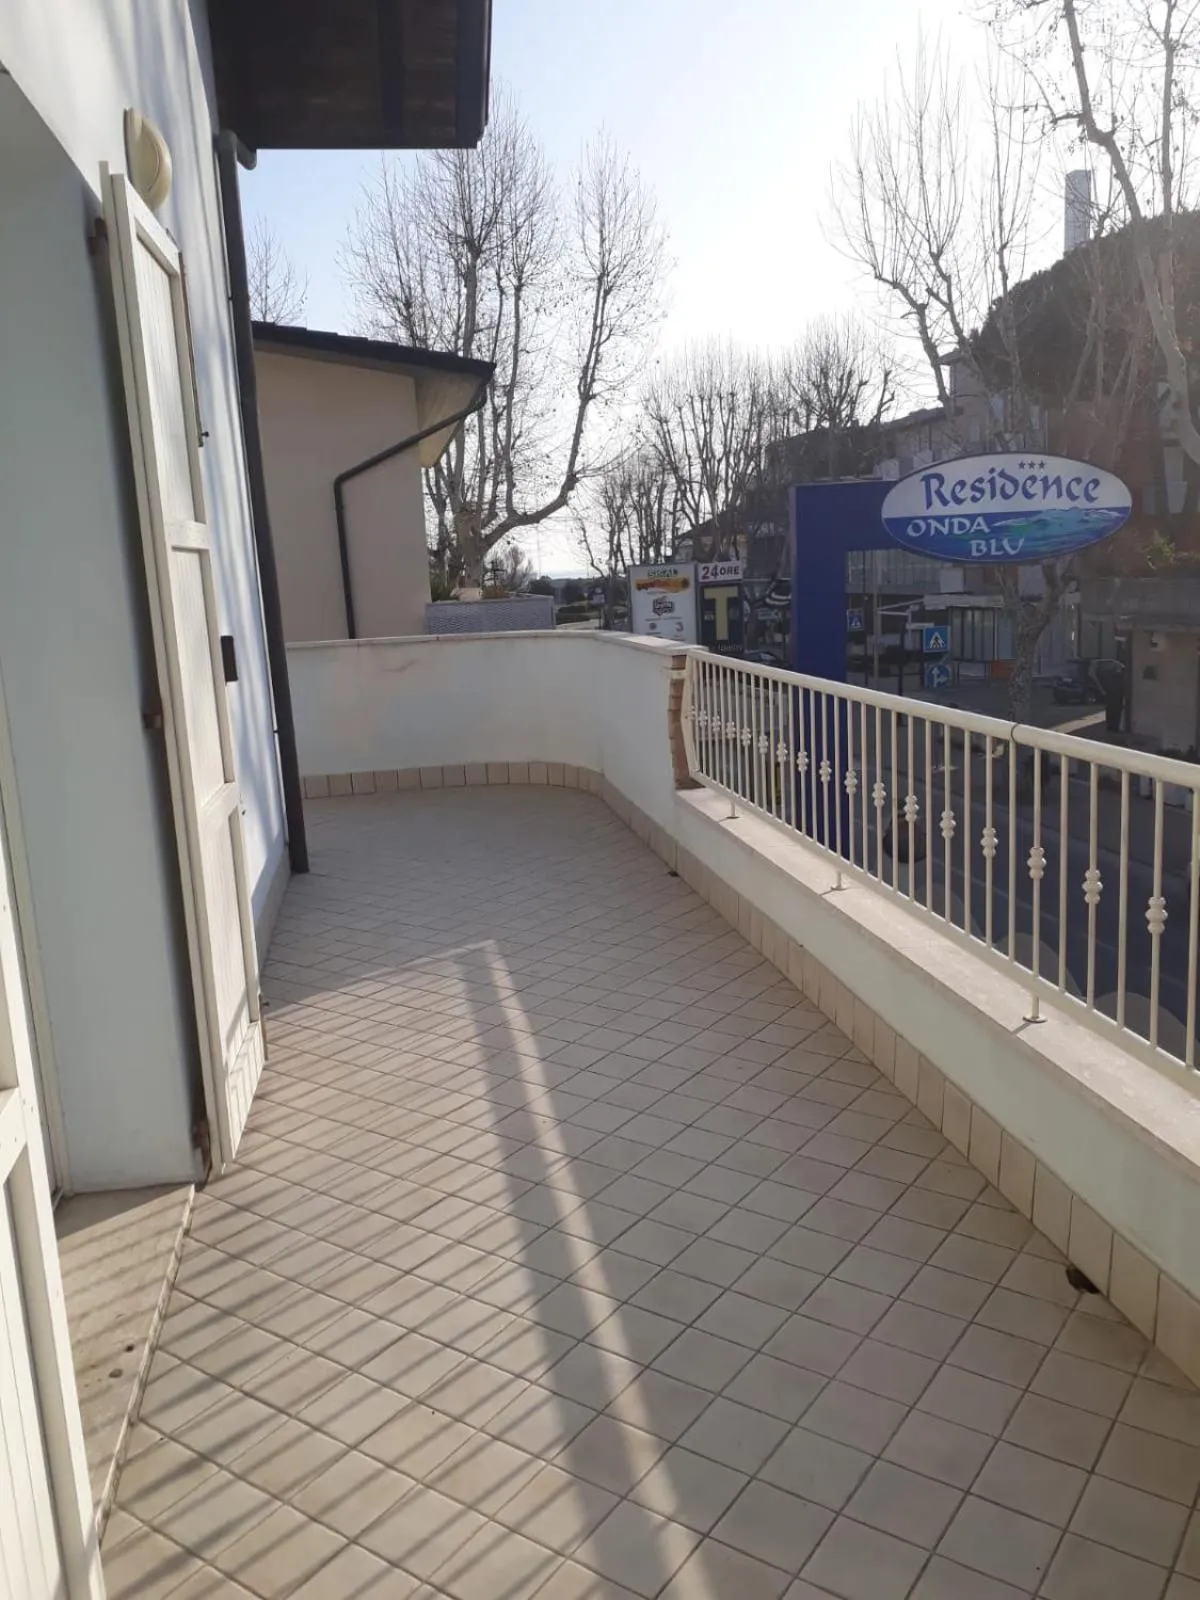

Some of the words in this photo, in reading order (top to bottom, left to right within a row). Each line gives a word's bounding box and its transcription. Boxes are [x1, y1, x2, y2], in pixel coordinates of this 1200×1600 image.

[920, 467, 1101, 510] Residence
[906, 515, 991, 537] ONDA
[969, 538, 1025, 557] BLU
[702, 564, 719, 580] 24
[719, 565, 740, 577] ORE
